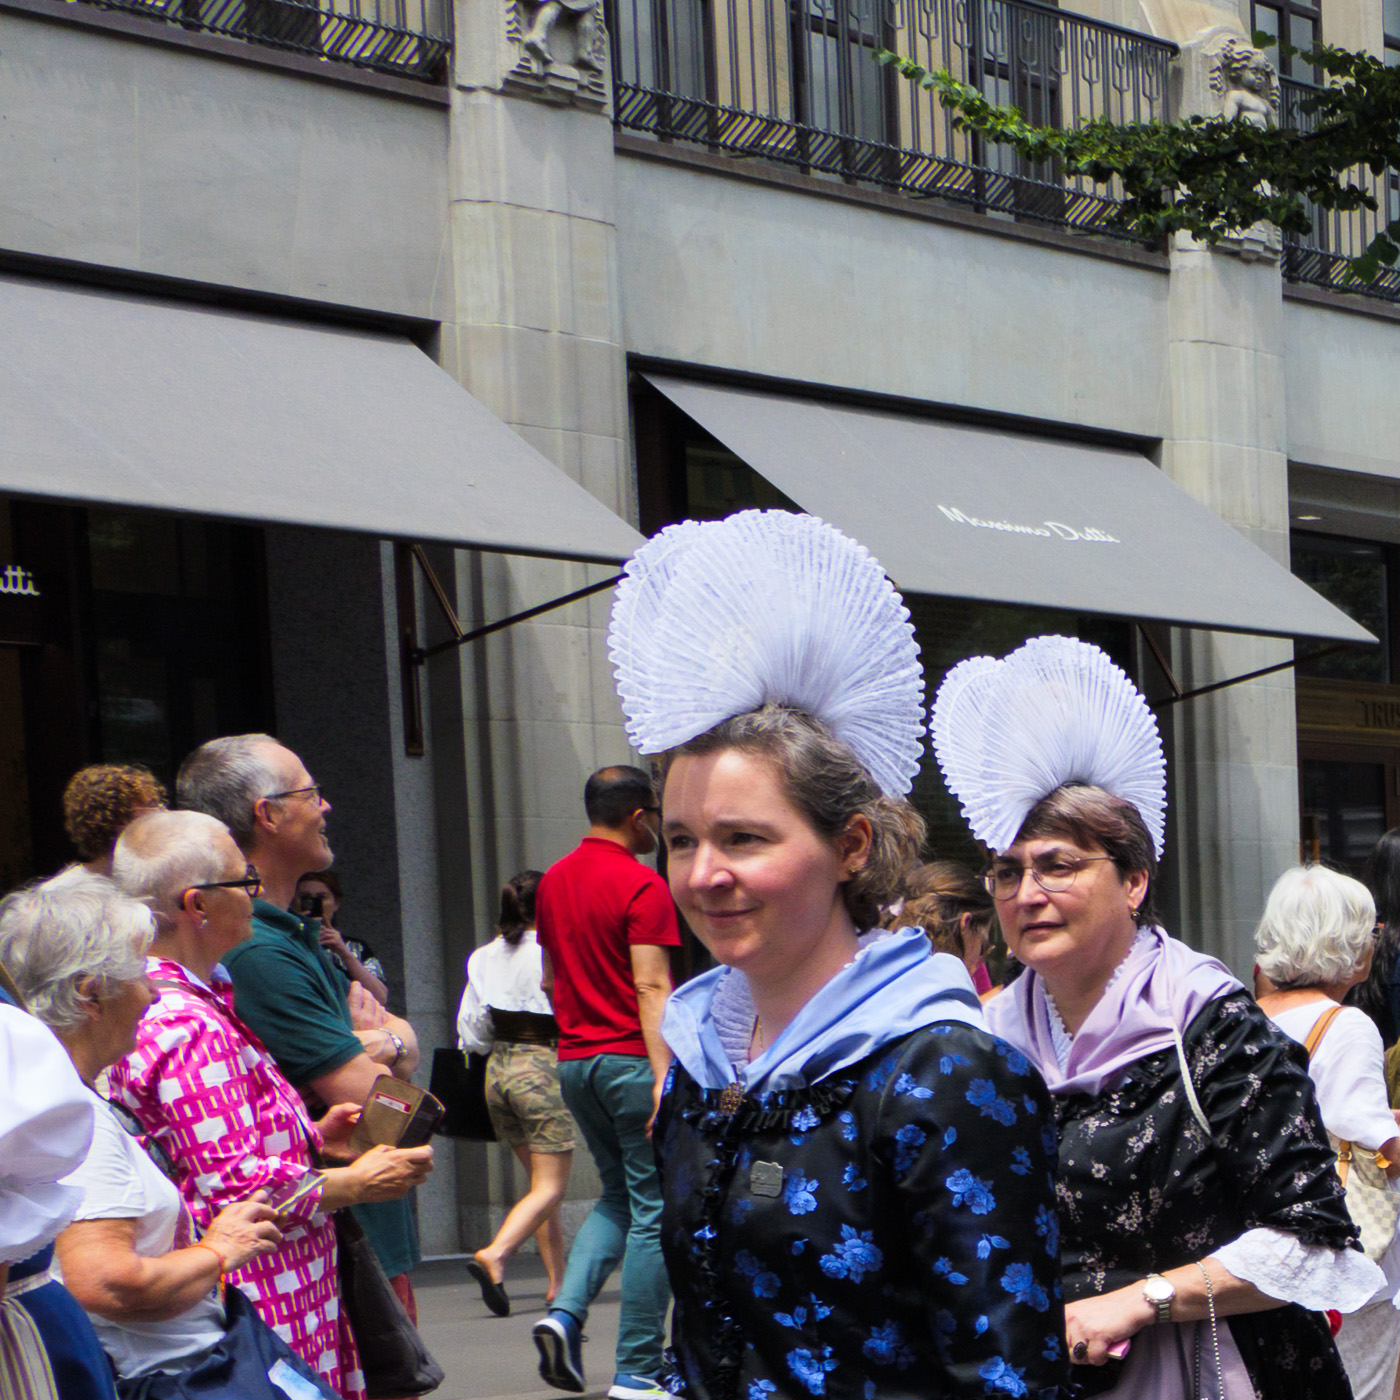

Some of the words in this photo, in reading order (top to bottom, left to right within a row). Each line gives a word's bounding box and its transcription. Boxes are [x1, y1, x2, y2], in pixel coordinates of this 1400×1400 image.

[937, 504, 1051, 537] Massimo
[1043, 521, 1120, 543] Dutti
[0, 565, 40, 596] tti
